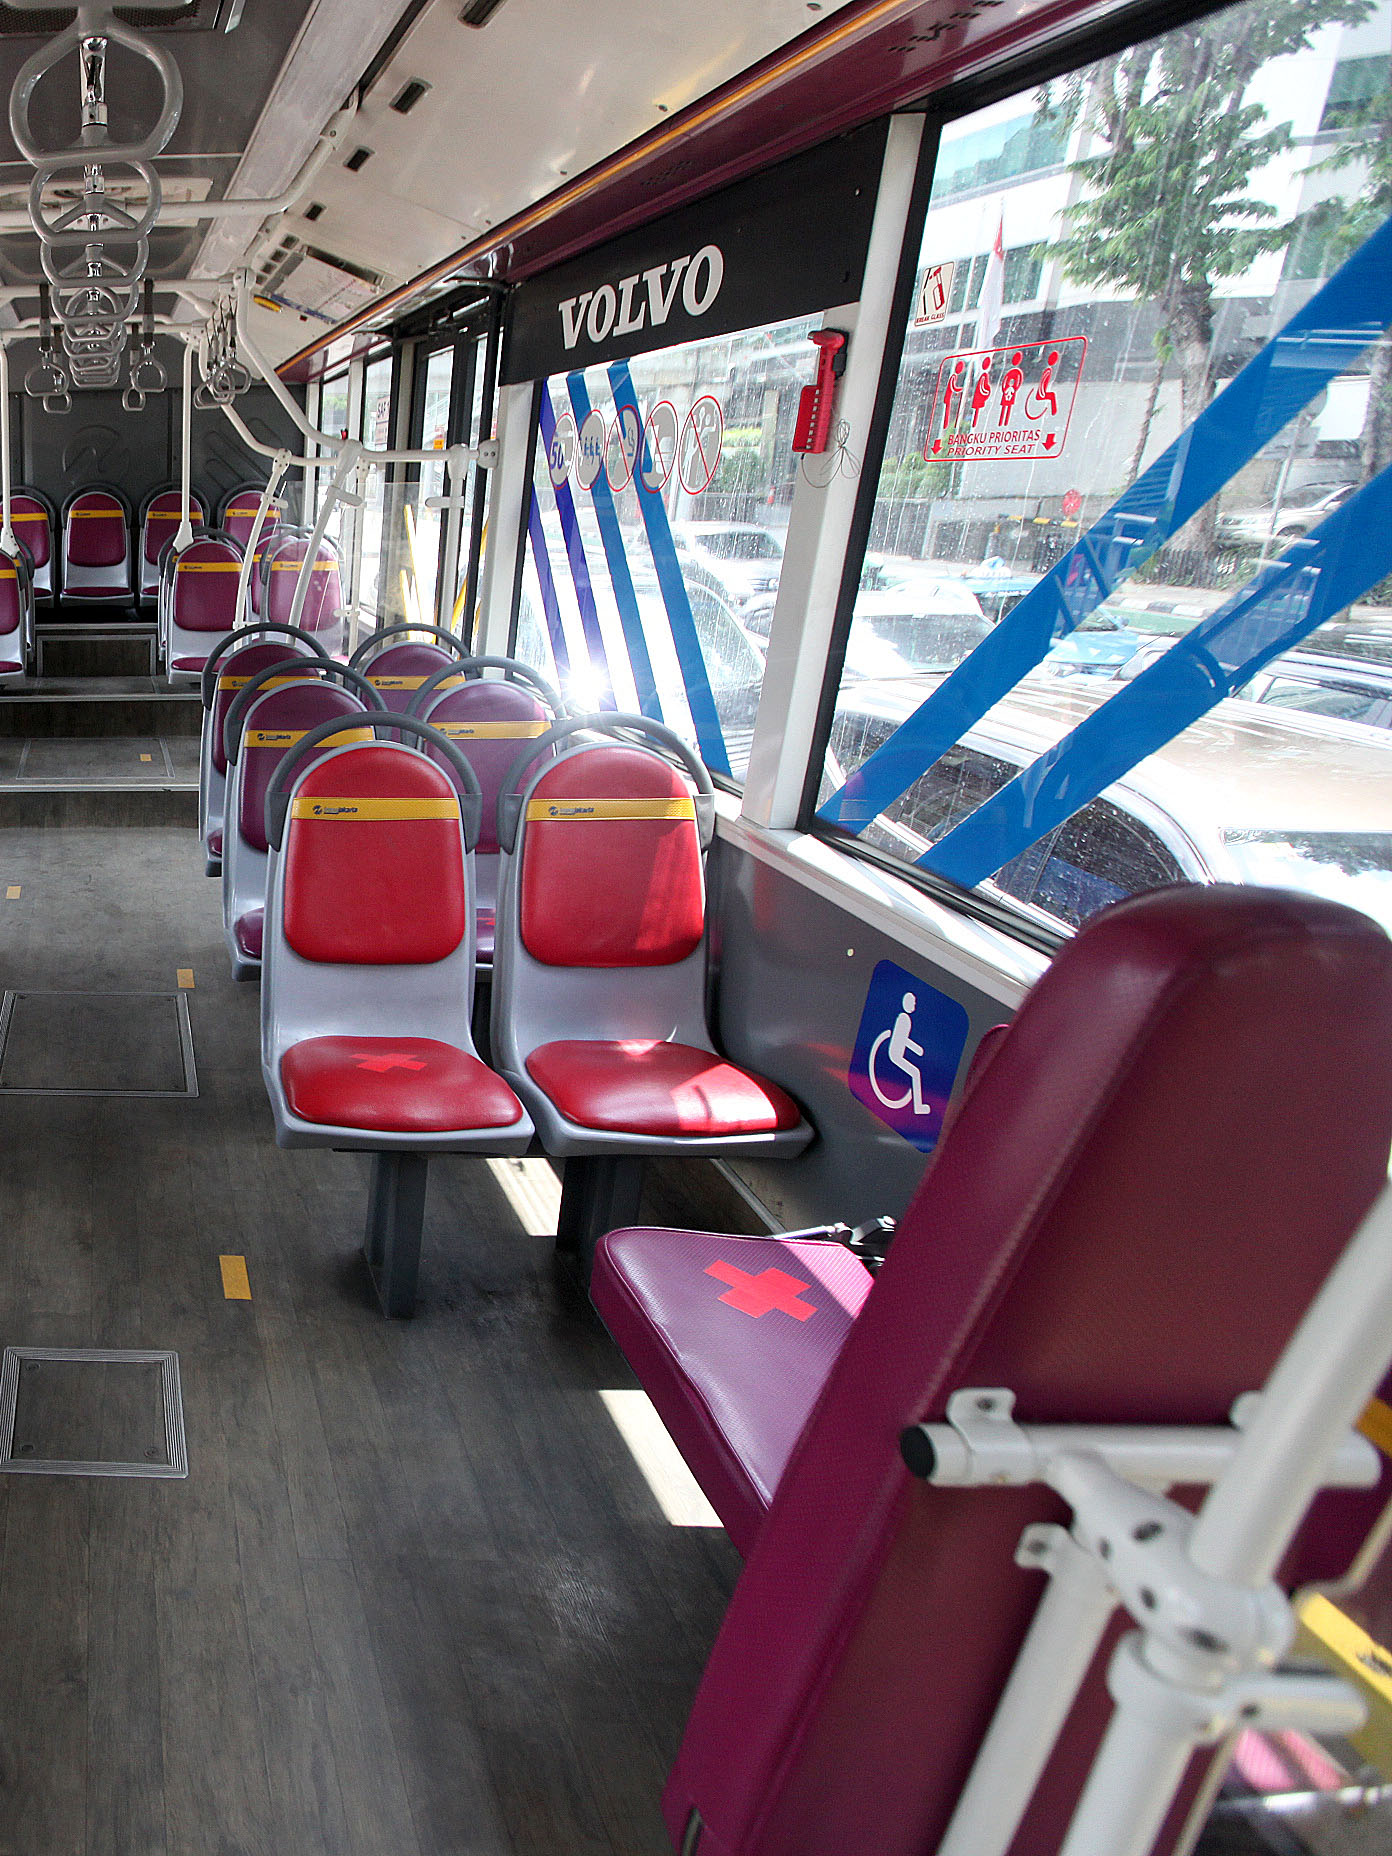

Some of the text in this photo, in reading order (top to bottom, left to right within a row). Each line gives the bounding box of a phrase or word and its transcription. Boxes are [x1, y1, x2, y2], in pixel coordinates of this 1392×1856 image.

[558, 244, 724, 350] VOLVO
[948, 429, 1041, 445] BANGKU PRIORITAS
[947, 443, 1035, 456] PRIORITY SEAT
